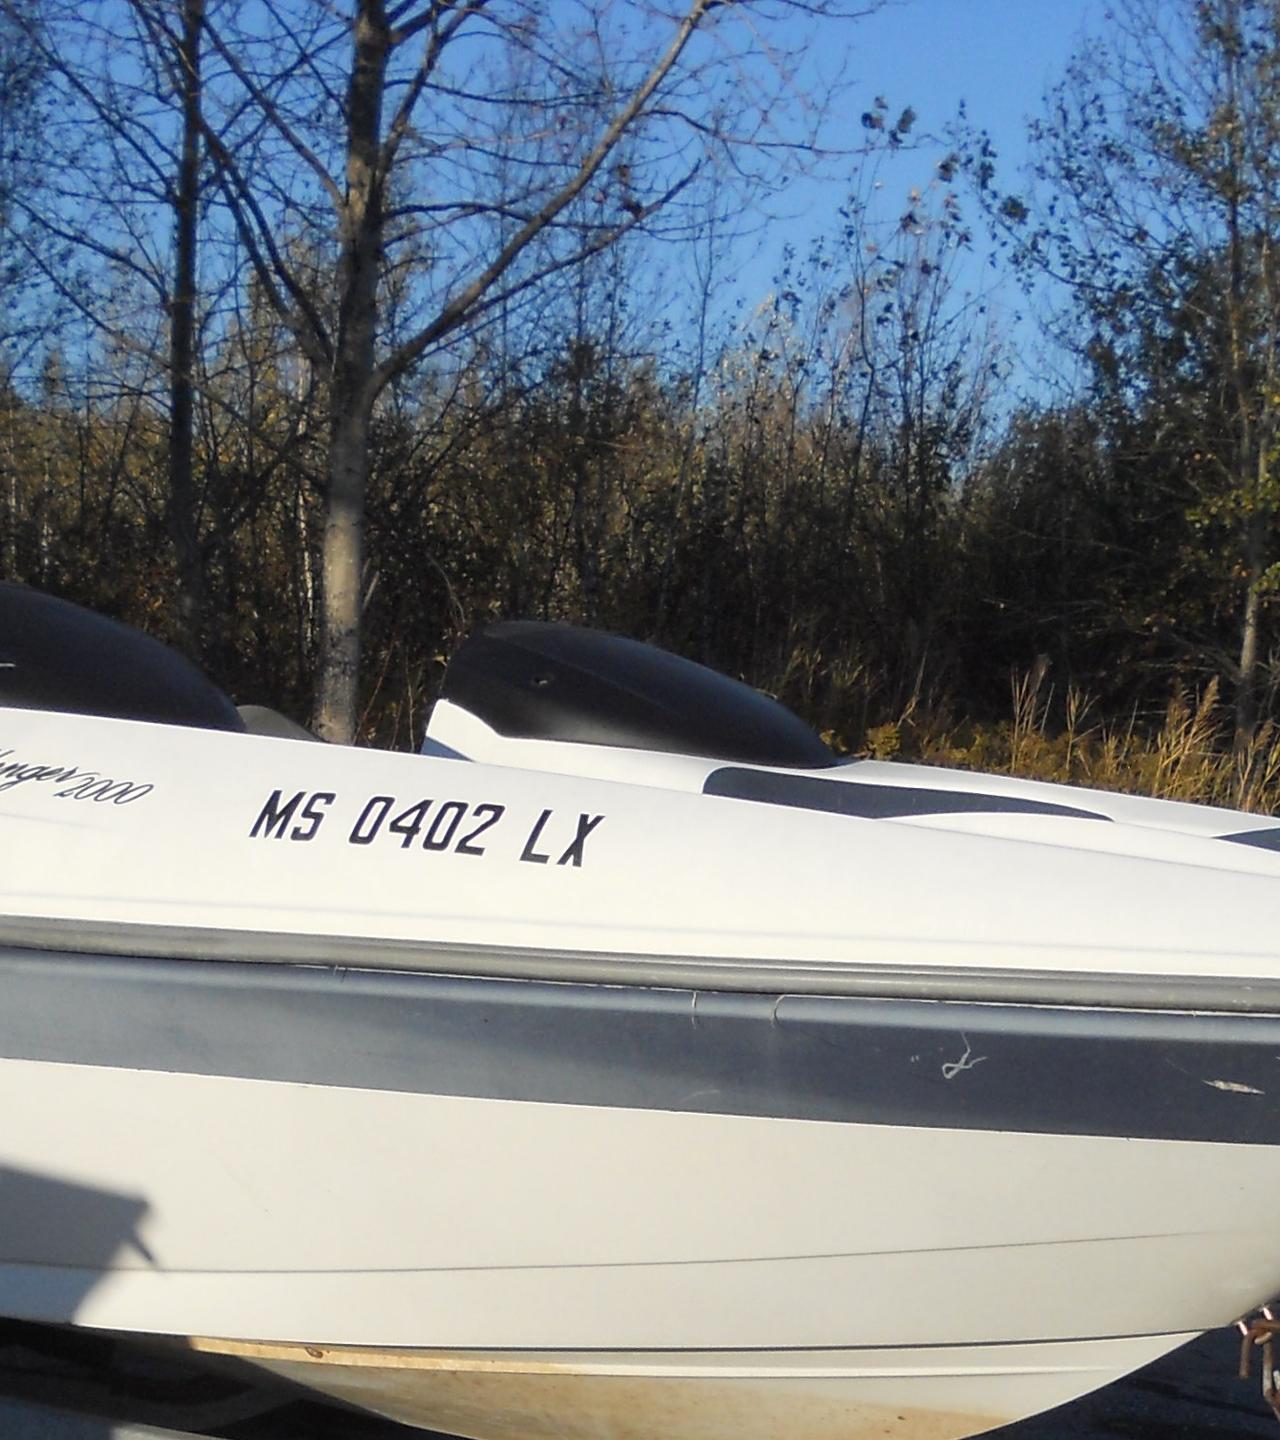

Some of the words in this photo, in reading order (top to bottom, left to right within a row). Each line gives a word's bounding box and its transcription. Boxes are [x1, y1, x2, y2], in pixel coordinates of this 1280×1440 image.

[54, 772, 154, 805] 2000
[249, 790, 336, 841] MS
[348, 796, 506, 856] 0402
[518, 809, 605, 868] LX
